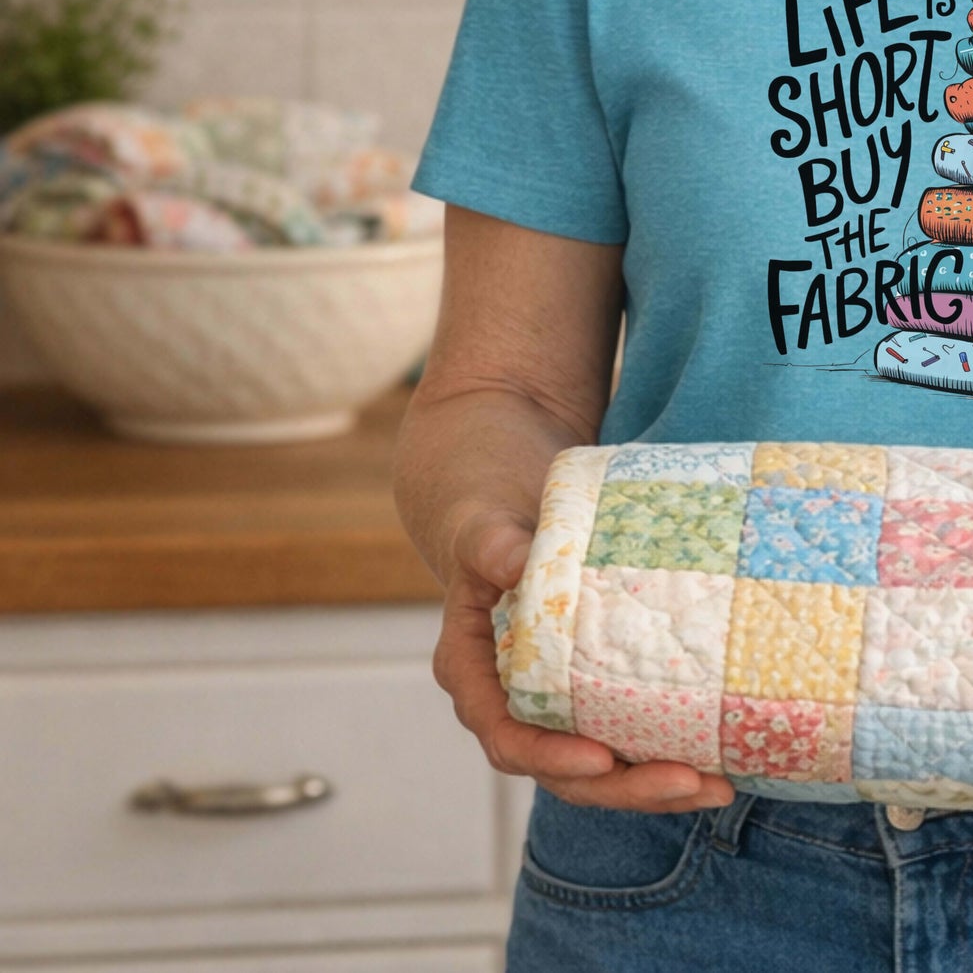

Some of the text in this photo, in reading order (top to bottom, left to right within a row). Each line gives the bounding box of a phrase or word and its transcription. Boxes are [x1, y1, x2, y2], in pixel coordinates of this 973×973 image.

[768, 30, 952, 159] SHORT
[798, 119, 912, 227] BUY
[805, 208, 891, 270] THE
[767, 248, 964, 356] FABRIC
